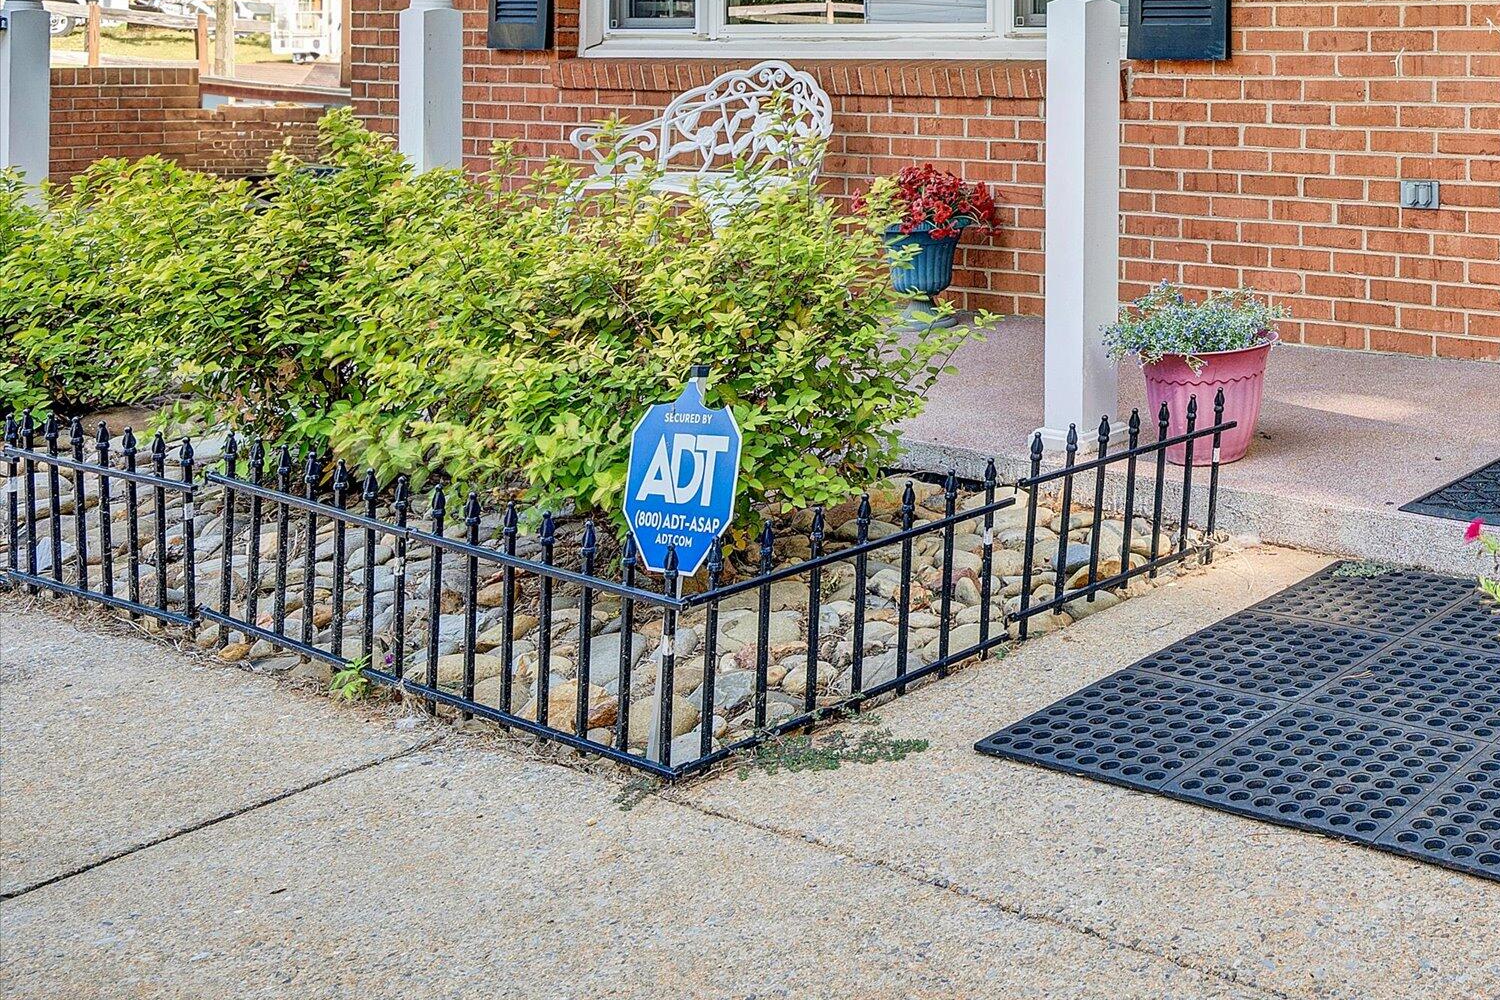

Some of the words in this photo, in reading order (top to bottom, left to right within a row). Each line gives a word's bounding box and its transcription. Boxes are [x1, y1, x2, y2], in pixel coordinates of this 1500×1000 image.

[664, 412, 700, 424] SECURED
[701, 413, 713, 425] BY
[635, 433, 729, 507] ADT
[634, 510, 662, 530] (800)
[662, 514, 720, 534] ADT-ASAP
[655, 533, 692, 548] ADTCOM
